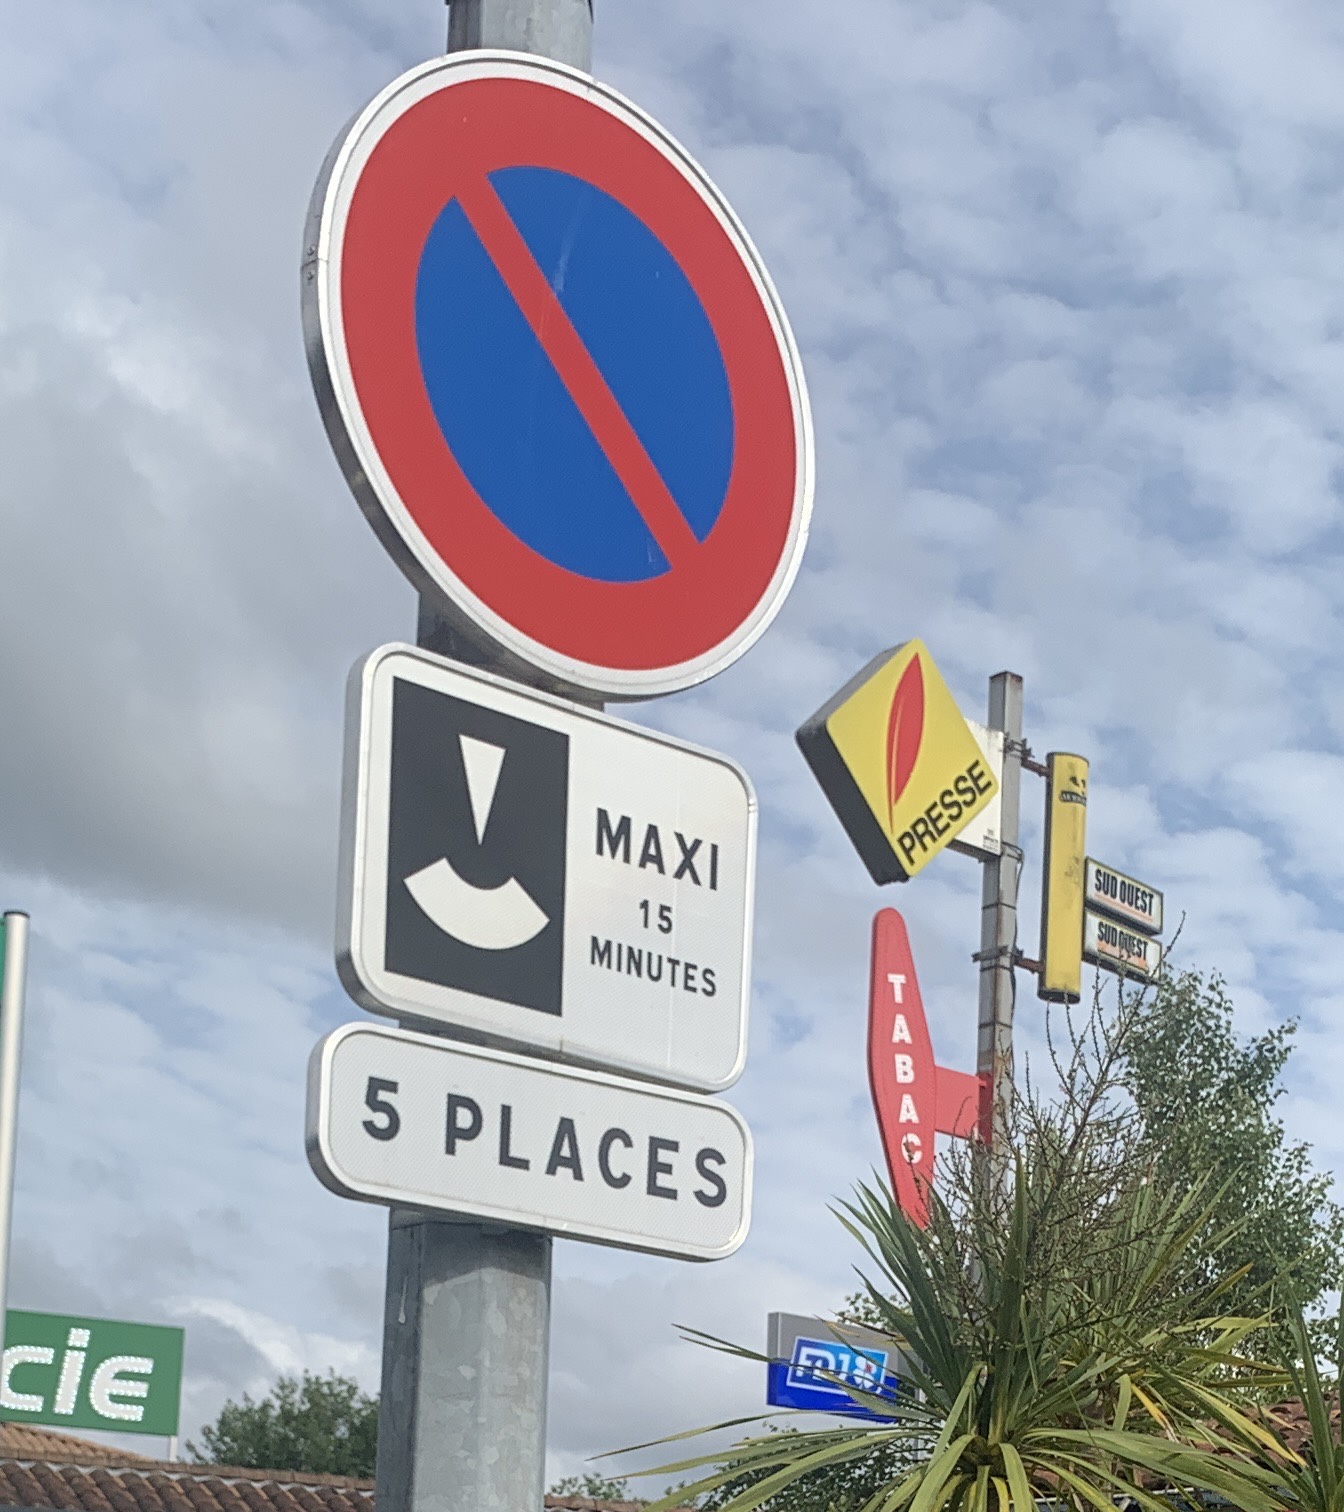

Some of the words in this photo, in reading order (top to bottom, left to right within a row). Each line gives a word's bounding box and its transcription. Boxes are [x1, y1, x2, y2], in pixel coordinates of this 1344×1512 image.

[897, 759, 993, 867] PRESSE
[596, 807, 719, 891] MAXI
[638, 899, 674, 935] 15
[1095, 868, 1118, 900] SUD
[1120, 880, 1154, 916] OUEST
[590, 936, 718, 998] MINUTES
[1098, 921, 1117, 948] SUD
[1119, 930, 1148, 961] OUEST
[887, 973, 923, 1165] TABAC
[362, 1076, 401, 1142] 5
[444, 1093, 728, 1208] PLACES
[795, 1346, 851, 1382] FDJ
